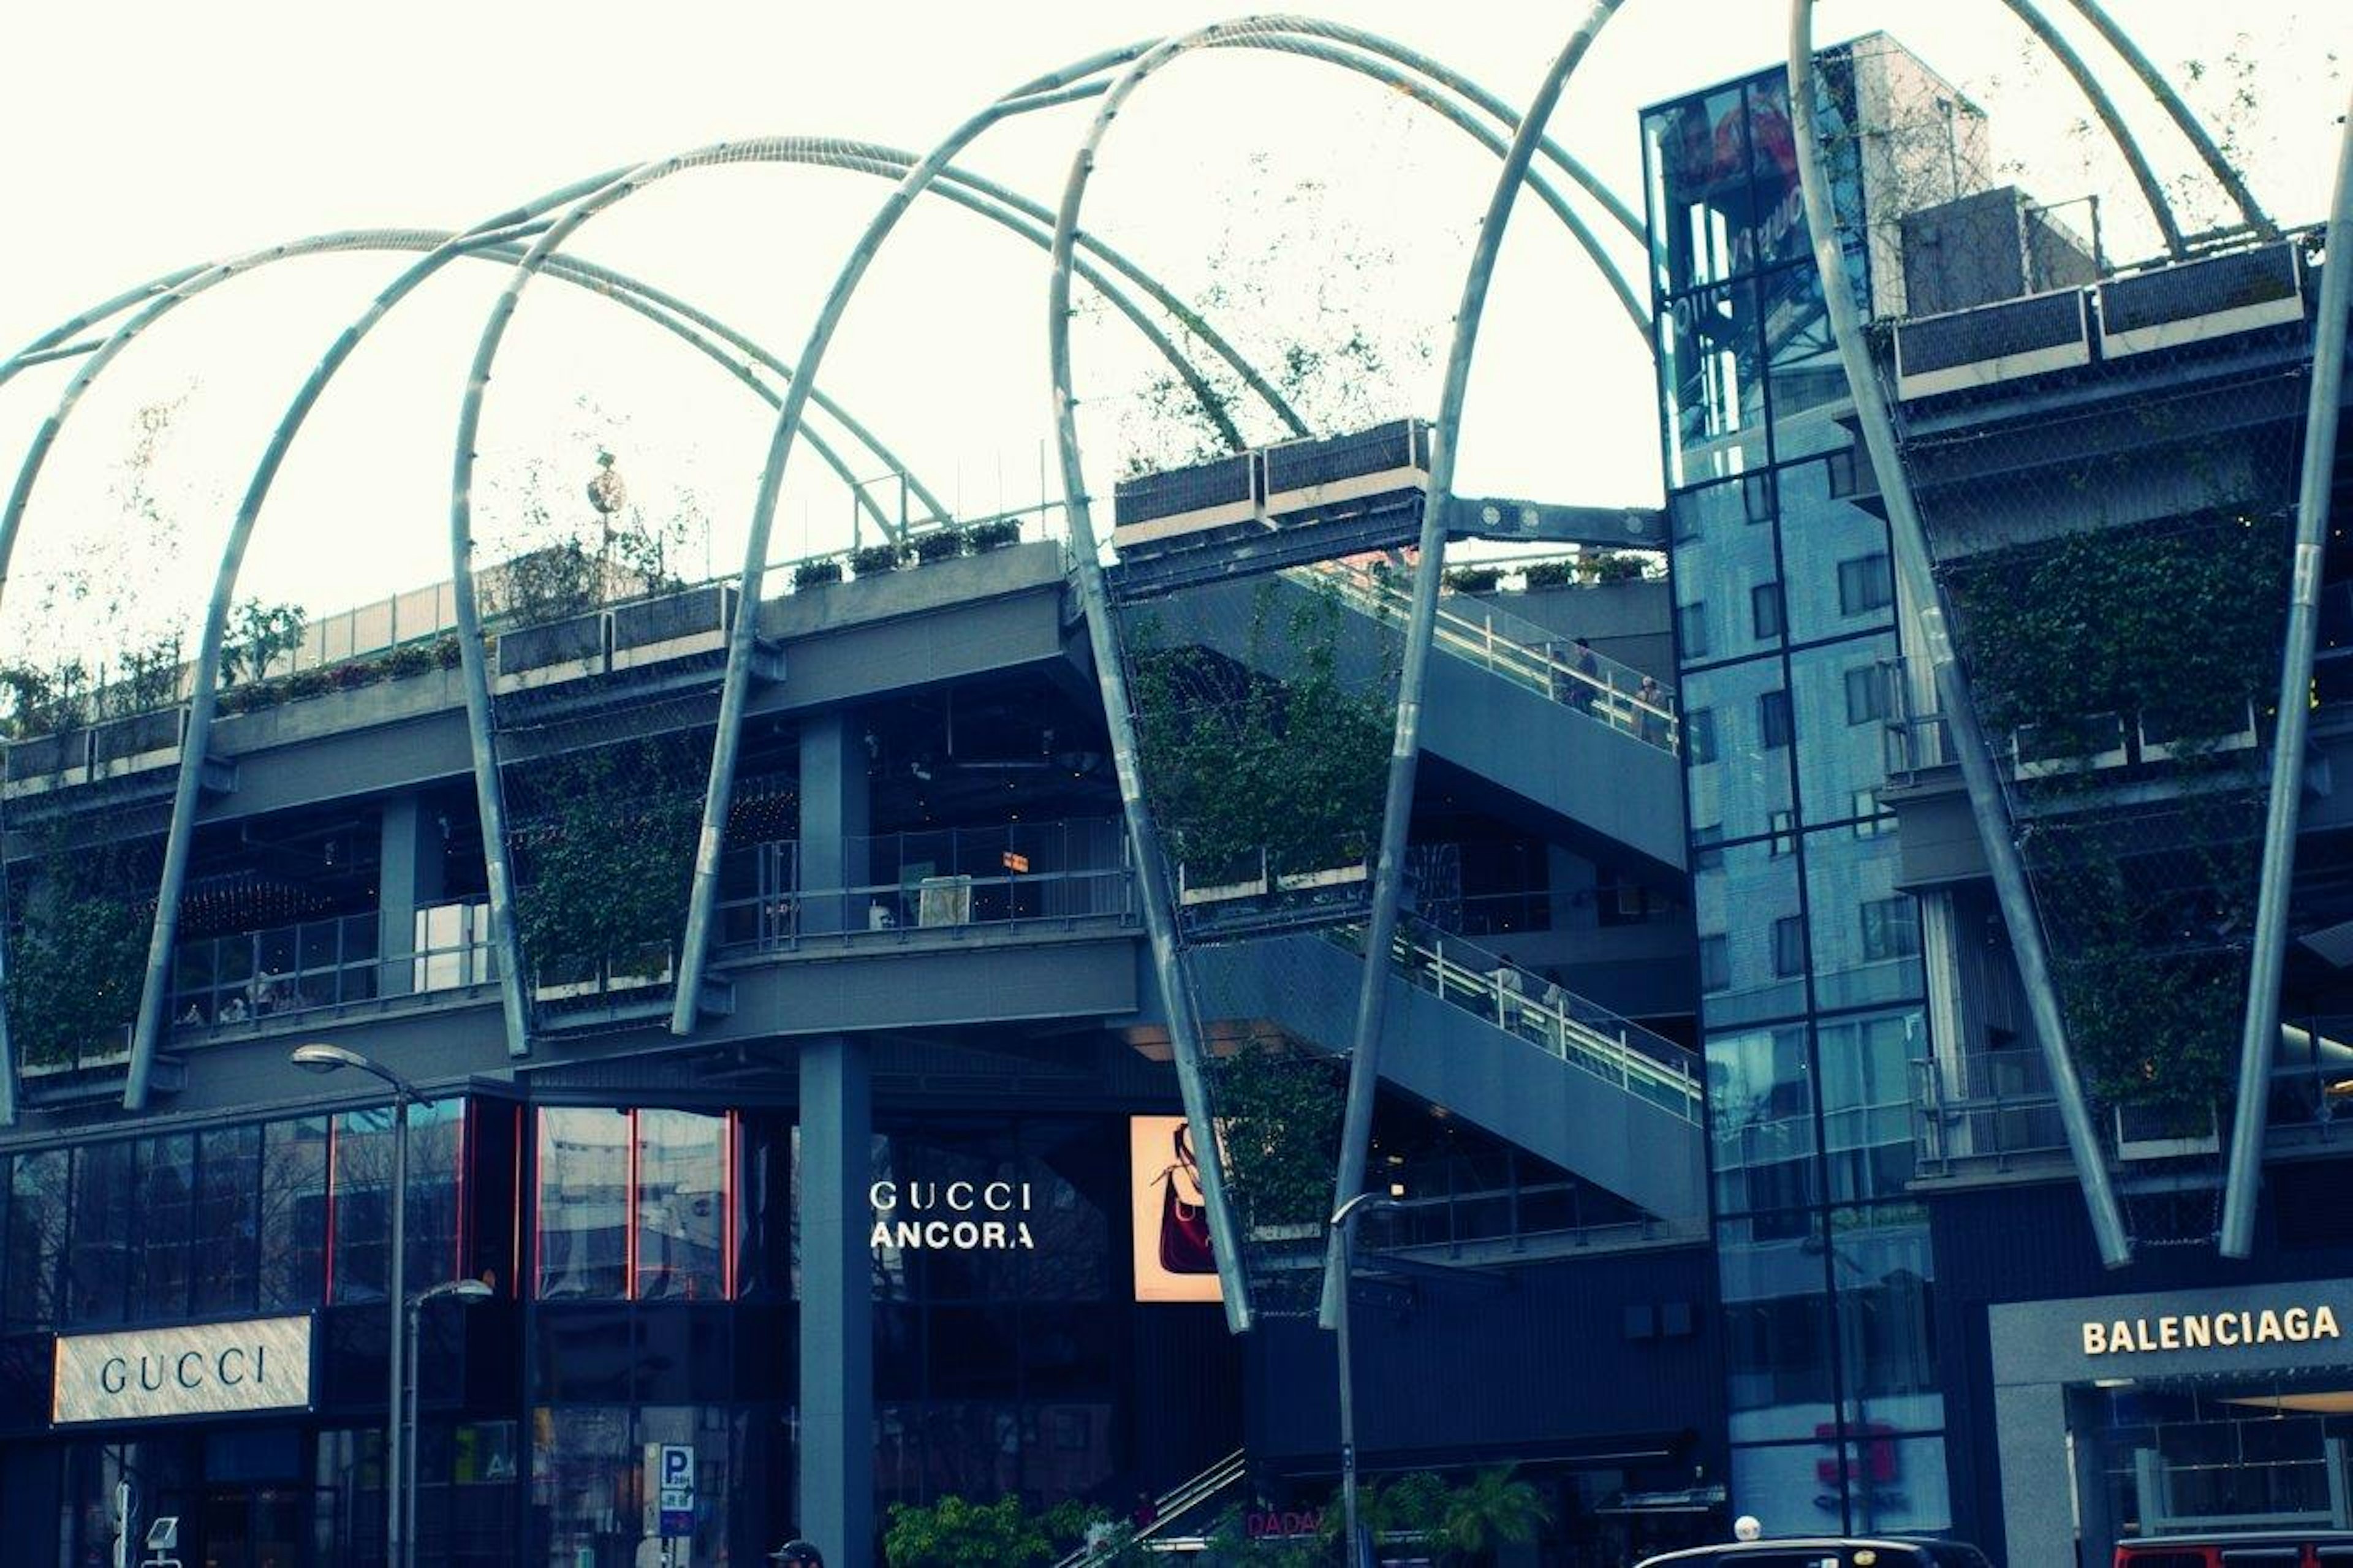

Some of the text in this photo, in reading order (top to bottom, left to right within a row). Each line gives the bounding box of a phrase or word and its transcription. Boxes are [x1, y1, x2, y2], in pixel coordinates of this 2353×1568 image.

[870, 1181, 1032, 1211] GUCCI
[870, 1221, 1036, 1249] ANCORA
[2082, 1305, 2341, 1355] BALENCIAGA
[100, 1346, 264, 1394] GUCCI
[665, 1450, 688, 1483] P
